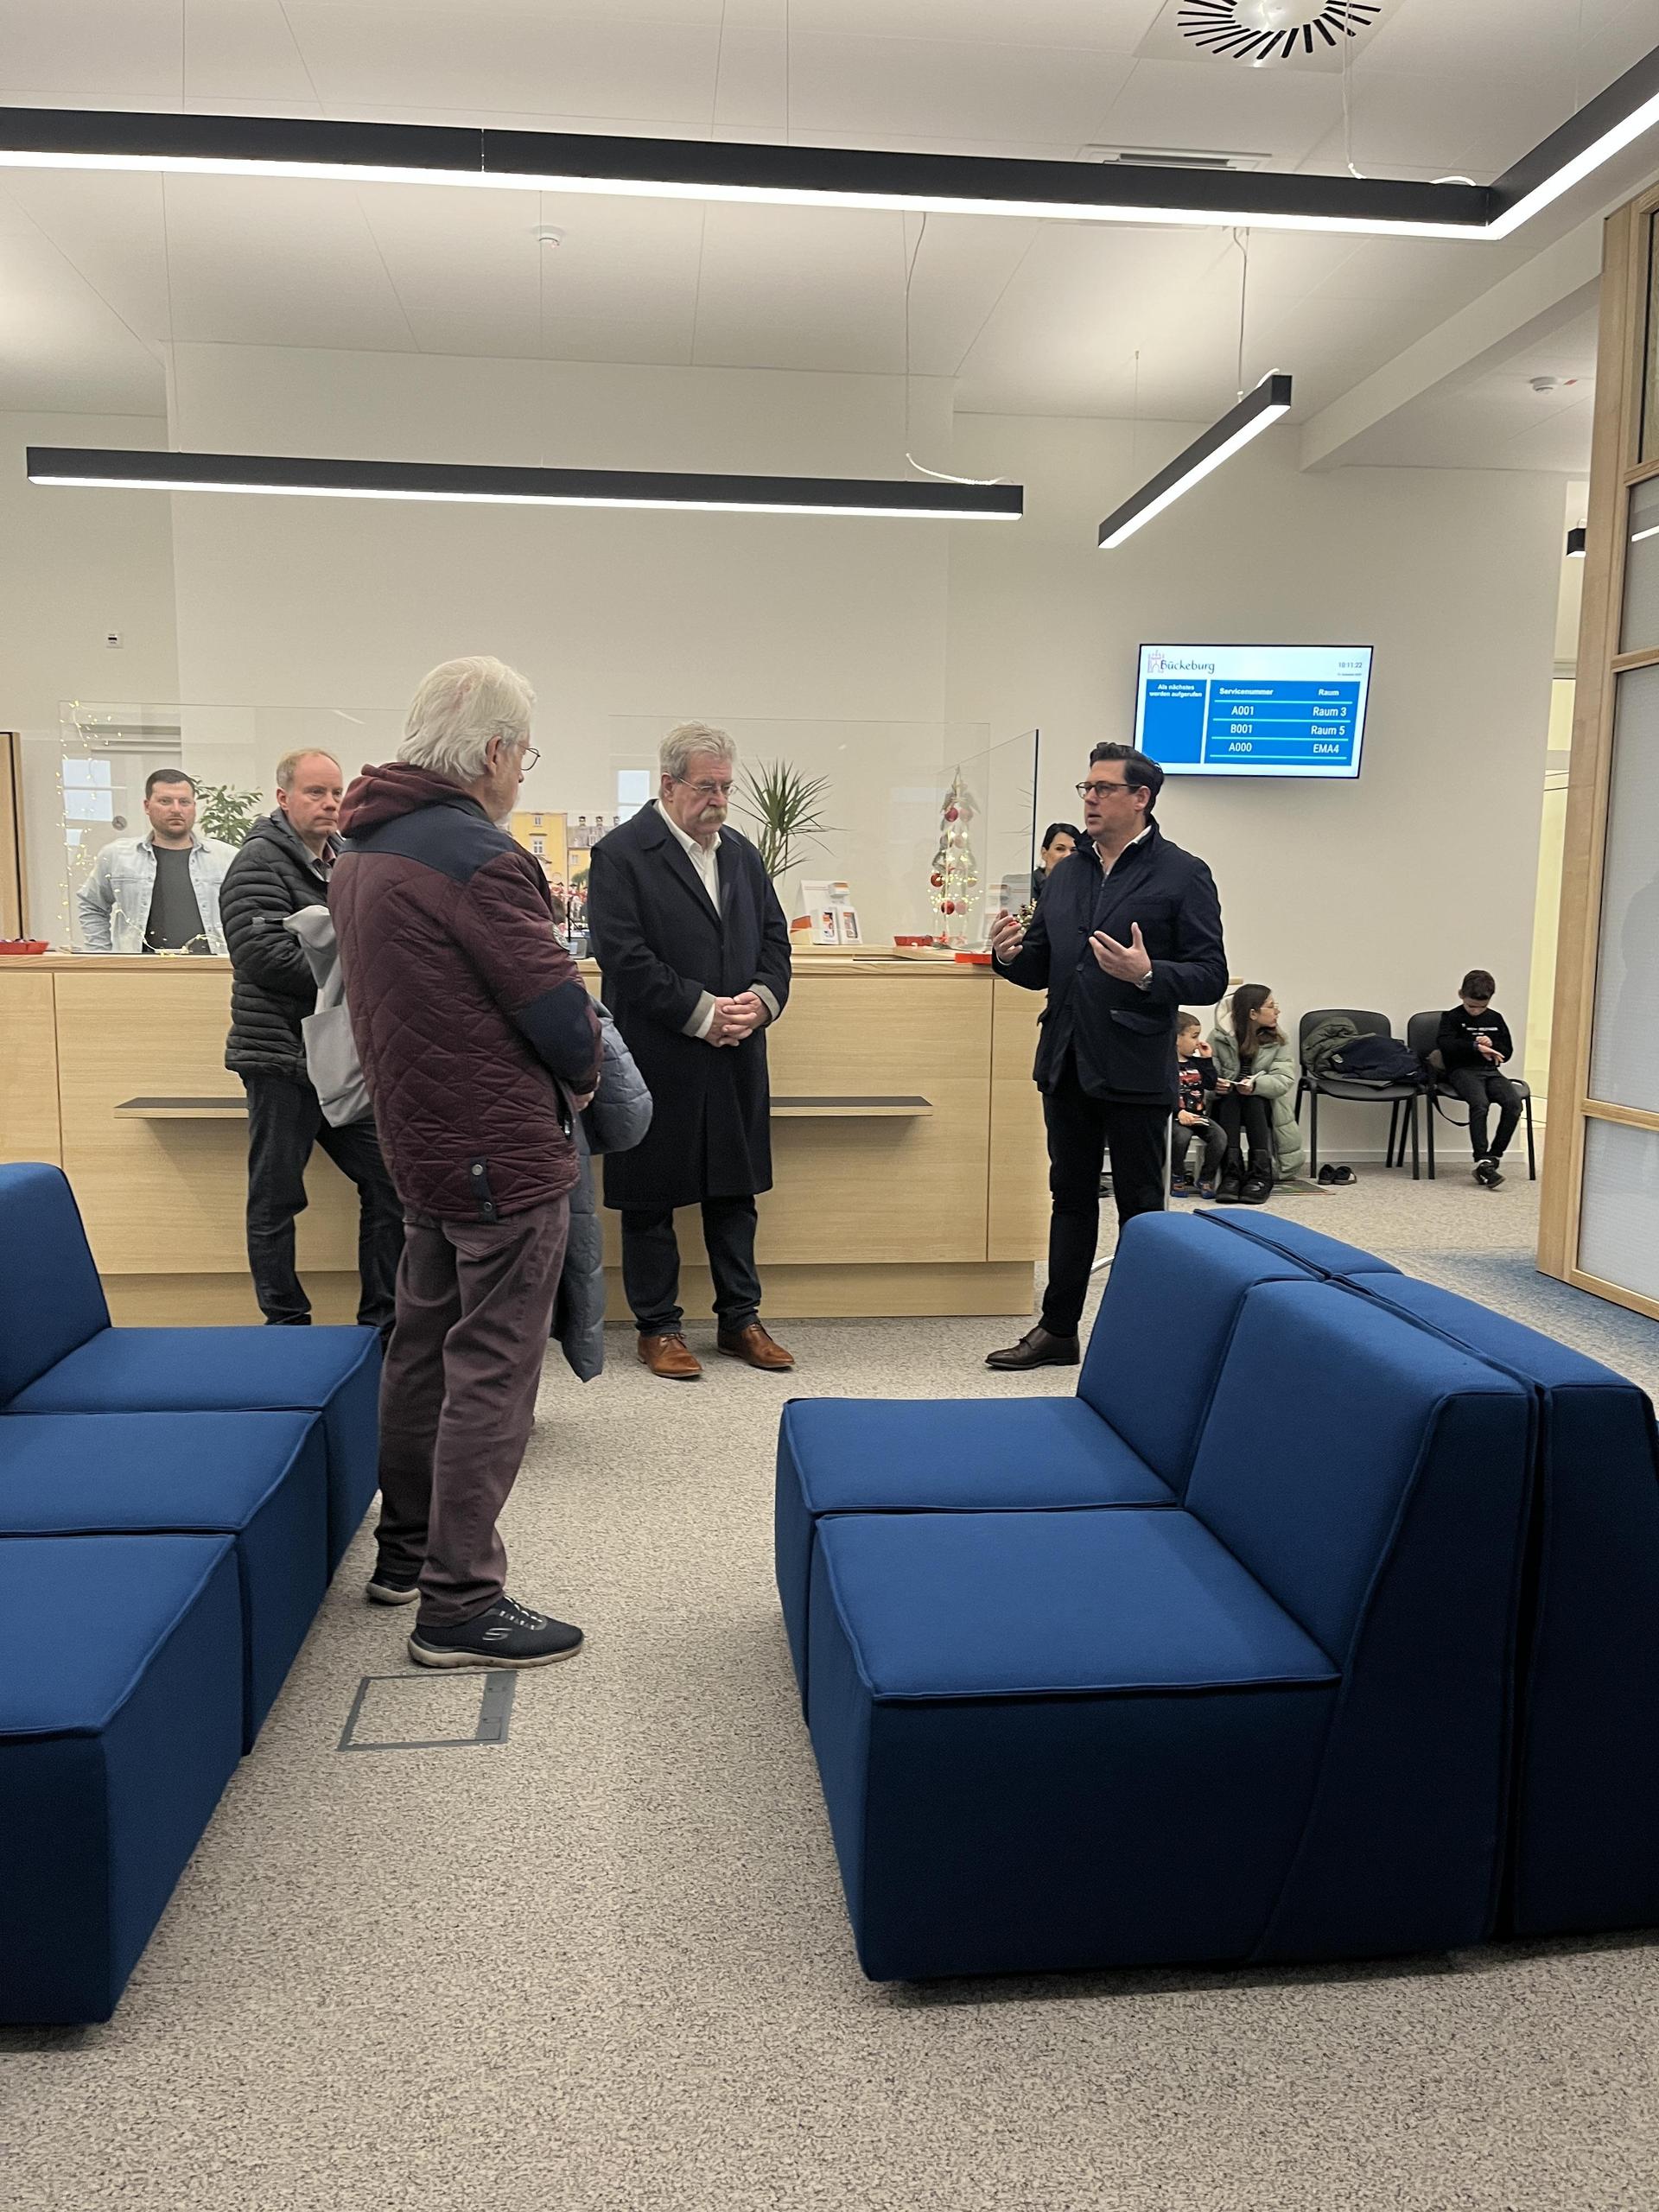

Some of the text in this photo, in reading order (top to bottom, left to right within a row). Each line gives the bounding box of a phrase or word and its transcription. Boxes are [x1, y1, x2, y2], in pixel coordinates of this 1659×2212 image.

[1160, 659, 1215, 675] Bückeburg
[1231, 705, 1254, 715] A001
[1313, 706, 1347, 717] Raum 3
[1230, 724, 1253, 734] B001
[1311, 725, 1345, 735] Raum 5
[1229, 742, 1252, 753] A000
[1313, 744, 1339, 753] EMA4
